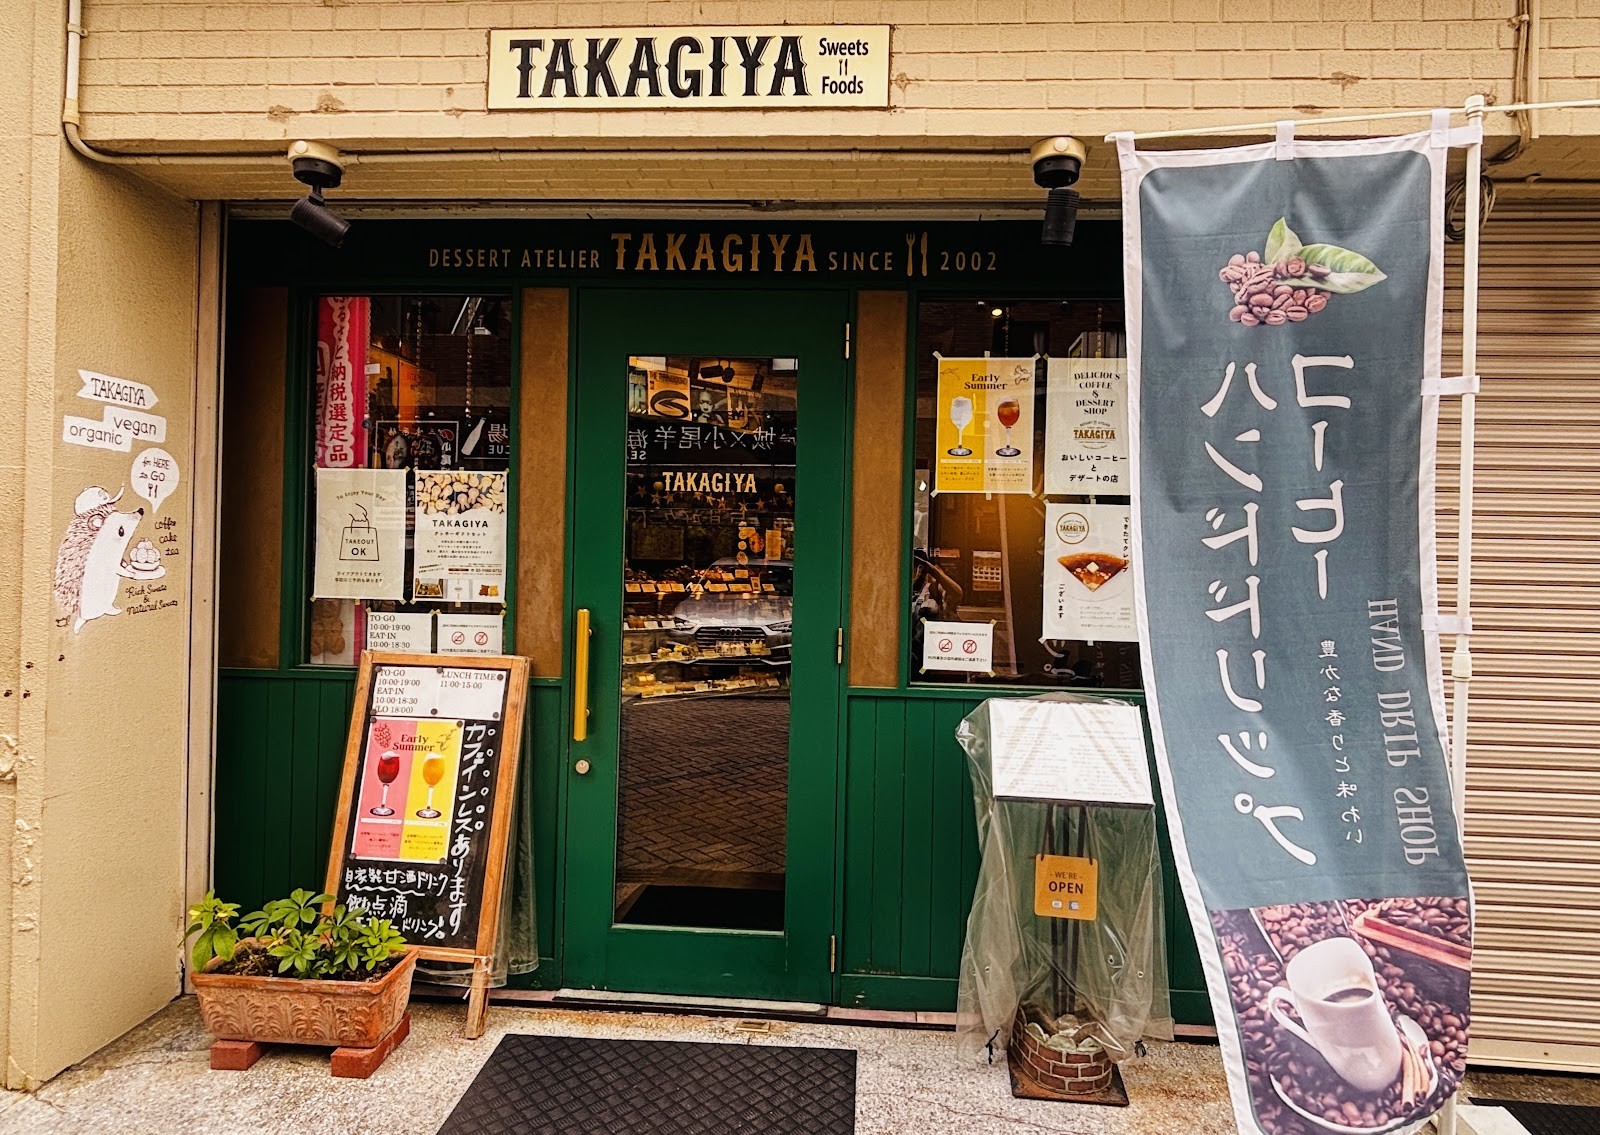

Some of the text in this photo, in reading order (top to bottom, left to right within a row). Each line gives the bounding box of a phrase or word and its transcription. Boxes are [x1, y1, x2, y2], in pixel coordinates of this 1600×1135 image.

[818, 37, 869, 57] Sweets
[509, 35, 811, 99] TAKAGIYA
[821, 76, 864, 95] Foods
[428, 233, 997, 273] DESSERT ATELIER TAKAGIYA SINCE 2002
[971, 373, 1000, 383] Early
[1073, 371, 1121, 381] DELICIOUS
[964, 381, 1008, 390] Summer
[1078, 381, 1113, 390] COFFEE
[91, 377, 146, 406] TAKAGIYA
[1075, 399, 1116, 408] DESSERT
[1083, 407, 1108, 416] SHOP
[113, 417, 157, 436] vegan
[69, 424, 123, 445] organic
[1073, 429, 1116, 440] TAKAGIYA
[1061, 453, 1128, 462] おいしいコーヒー
[153, 457, 170, 470] HERE
[1090, 464, 1097, 472] と
[150, 471, 165, 482] GO
[1069, 474, 1119, 484] デザートの店
[662, 472, 758, 493] TAKAGIYA
[432, 519, 489, 528] TAKAGIYA
[159, 532, 178, 544] cake
[165, 547, 179, 556] tea
[351, 547, 367, 556] OK
[441, 671, 497, 681] LUNCH TIME
[401, 733, 430, 744] Early
[392, 742, 435, 752] Summer
[1048, 880, 1084, 895] OPEN
